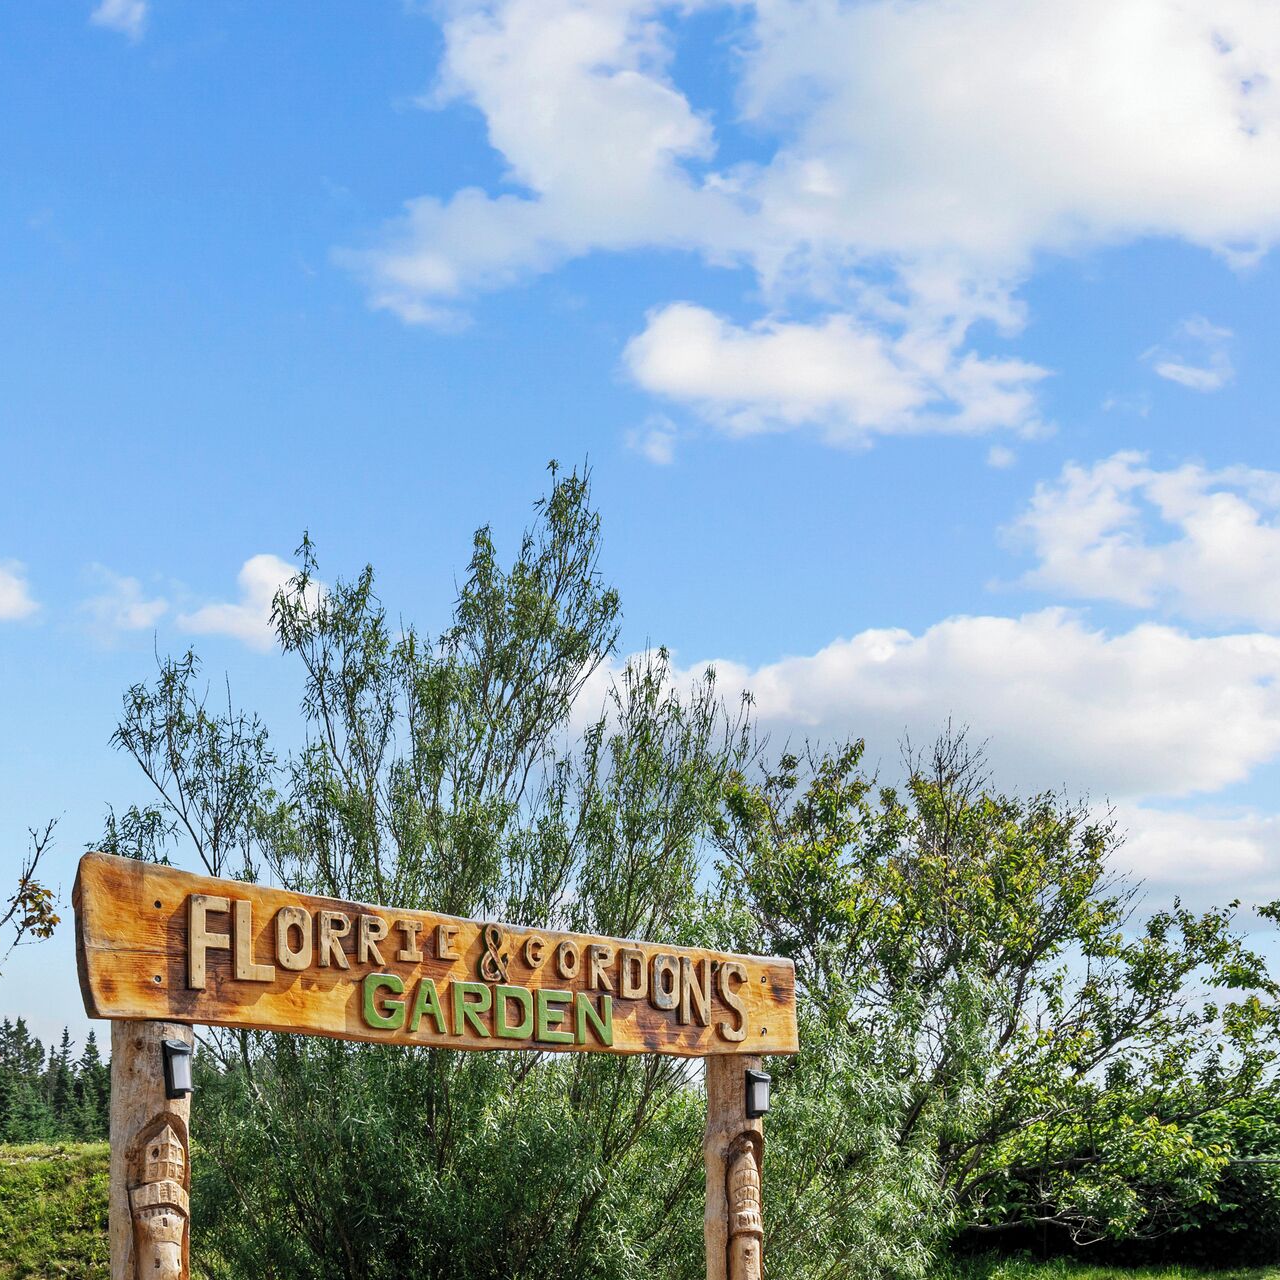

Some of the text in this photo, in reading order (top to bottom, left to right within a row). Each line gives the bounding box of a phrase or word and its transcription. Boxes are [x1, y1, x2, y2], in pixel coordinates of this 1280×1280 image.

[187, 893, 749, 1043] FLORRIE & GORDON'S
[362, 972, 615, 1048] GARDEN
